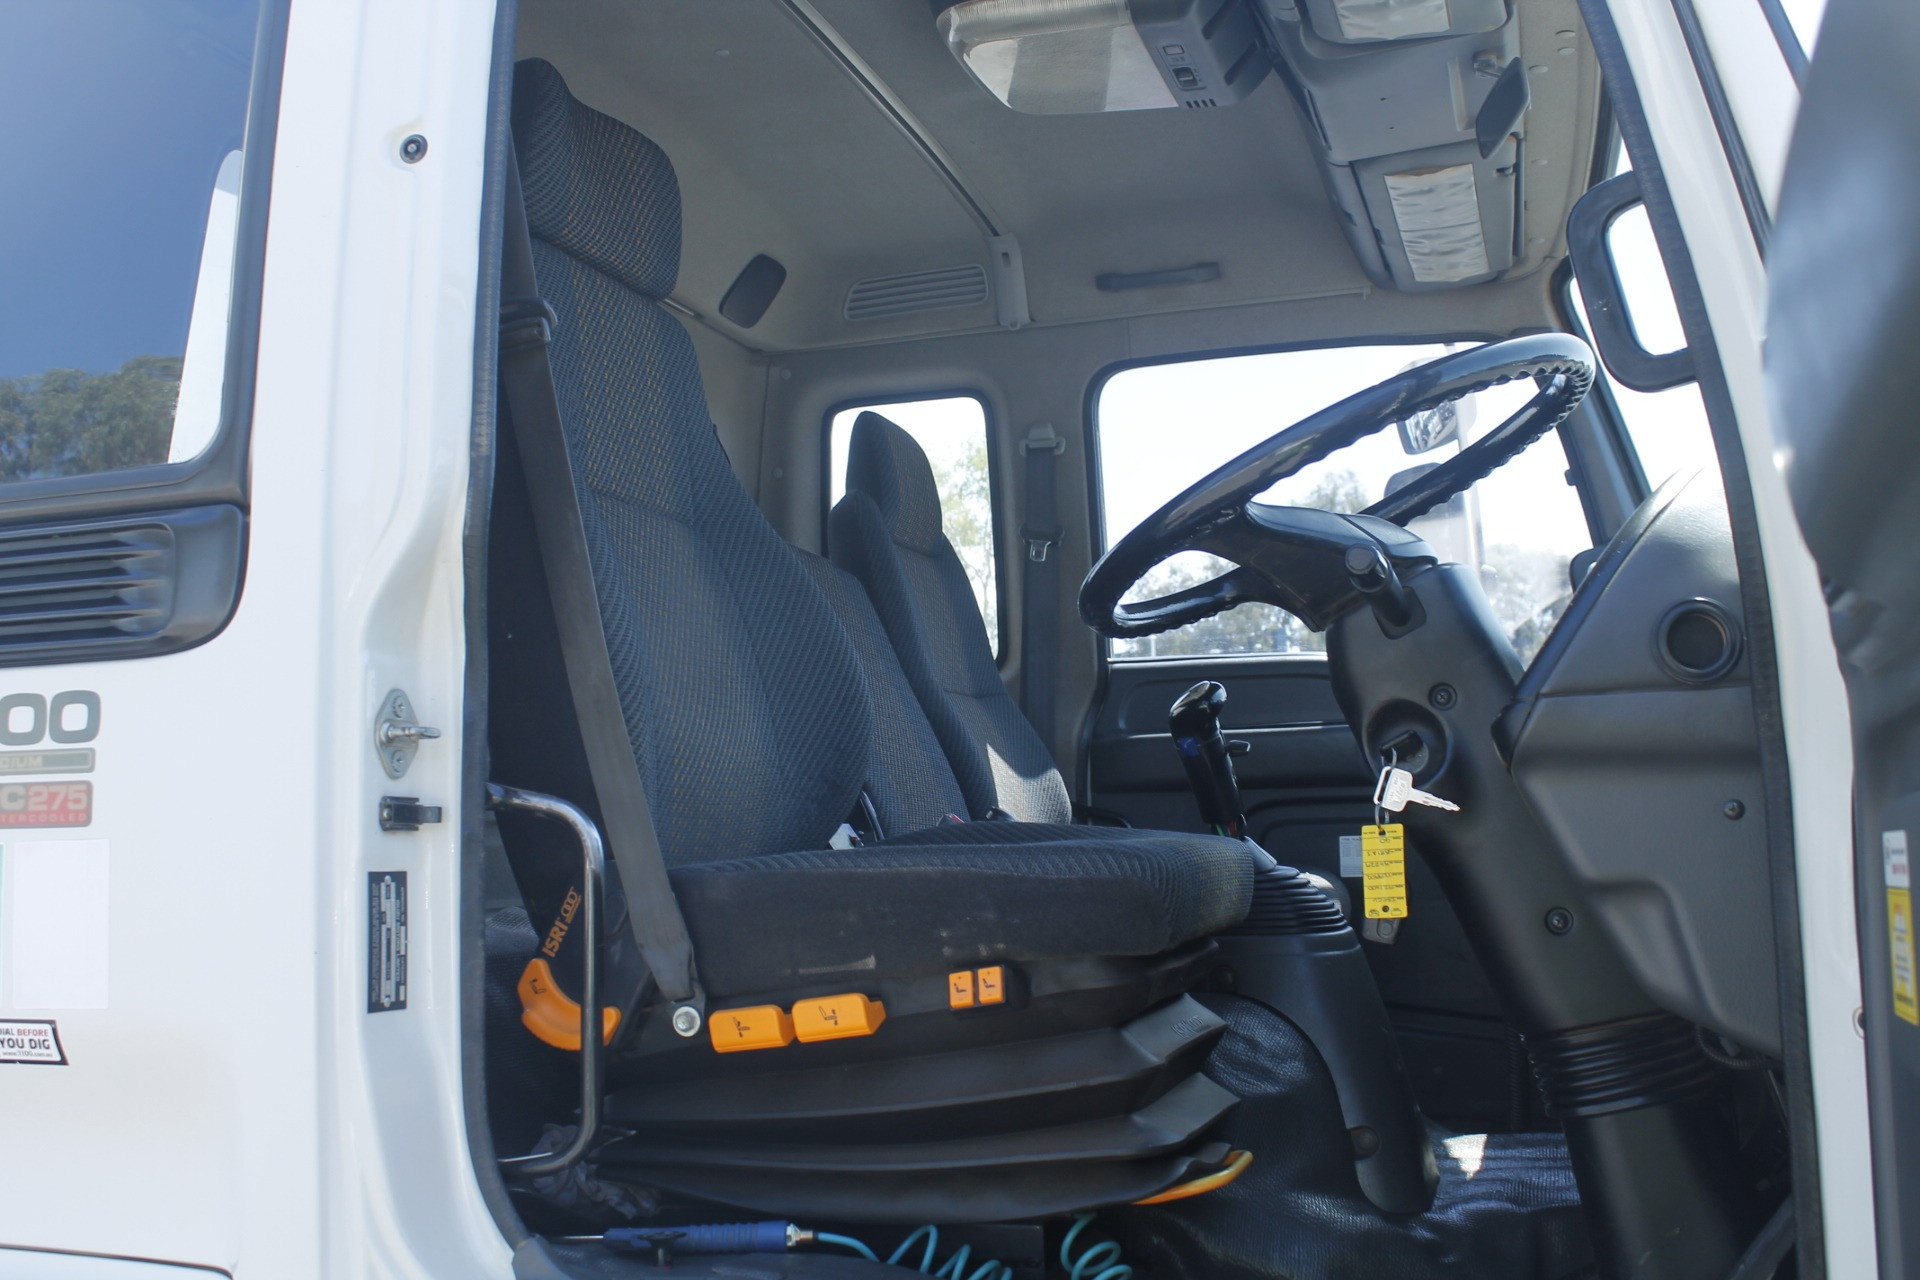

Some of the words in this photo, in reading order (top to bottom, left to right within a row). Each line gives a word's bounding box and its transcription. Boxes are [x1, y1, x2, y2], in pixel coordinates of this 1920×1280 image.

[542, 919, 569, 958] ISRI
[17, 1028, 49, 1037] BEFORE
[0, 1037, 25, 1049] YOU
[29, 1038, 51, 1050] DIG
